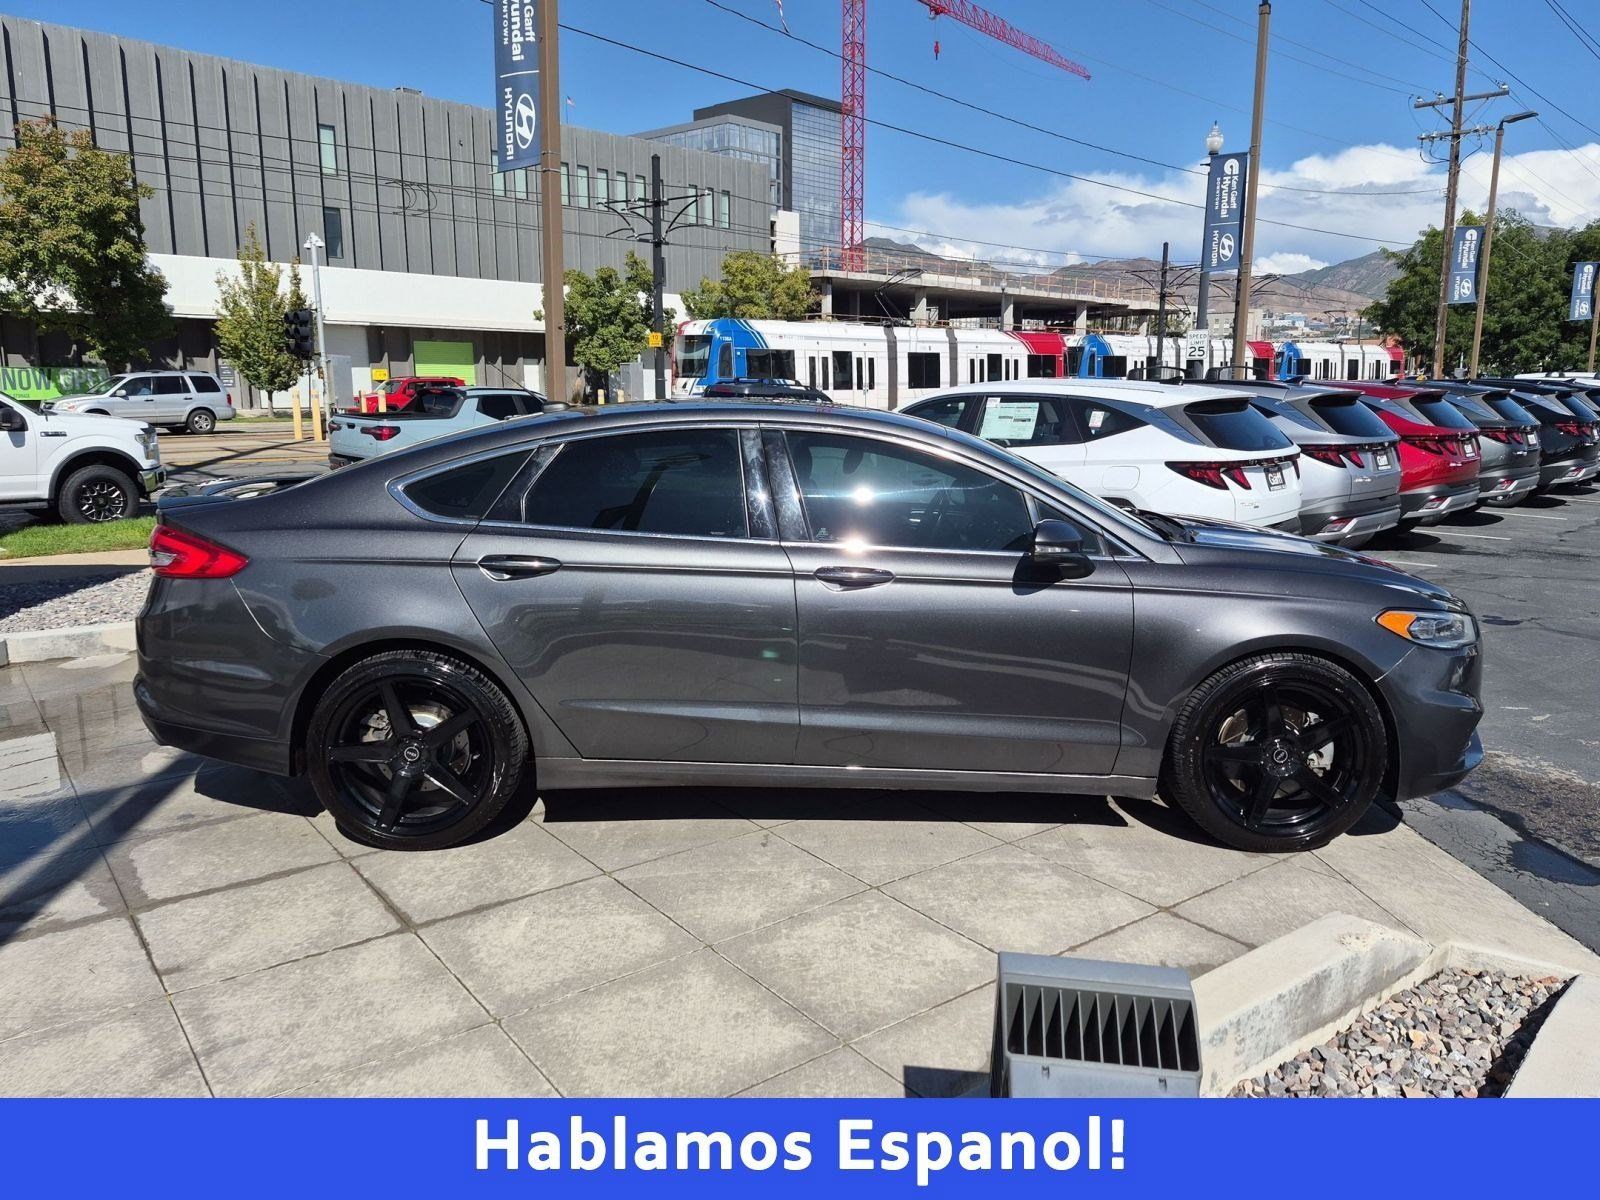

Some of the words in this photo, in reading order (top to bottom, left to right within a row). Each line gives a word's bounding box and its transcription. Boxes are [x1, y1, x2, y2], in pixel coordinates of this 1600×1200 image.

[524, 5, 536, 42] Garff
[504, 87, 514, 161] HYUNDAI
[1220, 176, 1231, 218] Hyundai
[1231, 175, 1239, 190] Ken
[1211, 230, 1219, 267] HYUNDAI
[1188, 346, 1205, 357] 25
[1, 367, 52, 391] NOW
